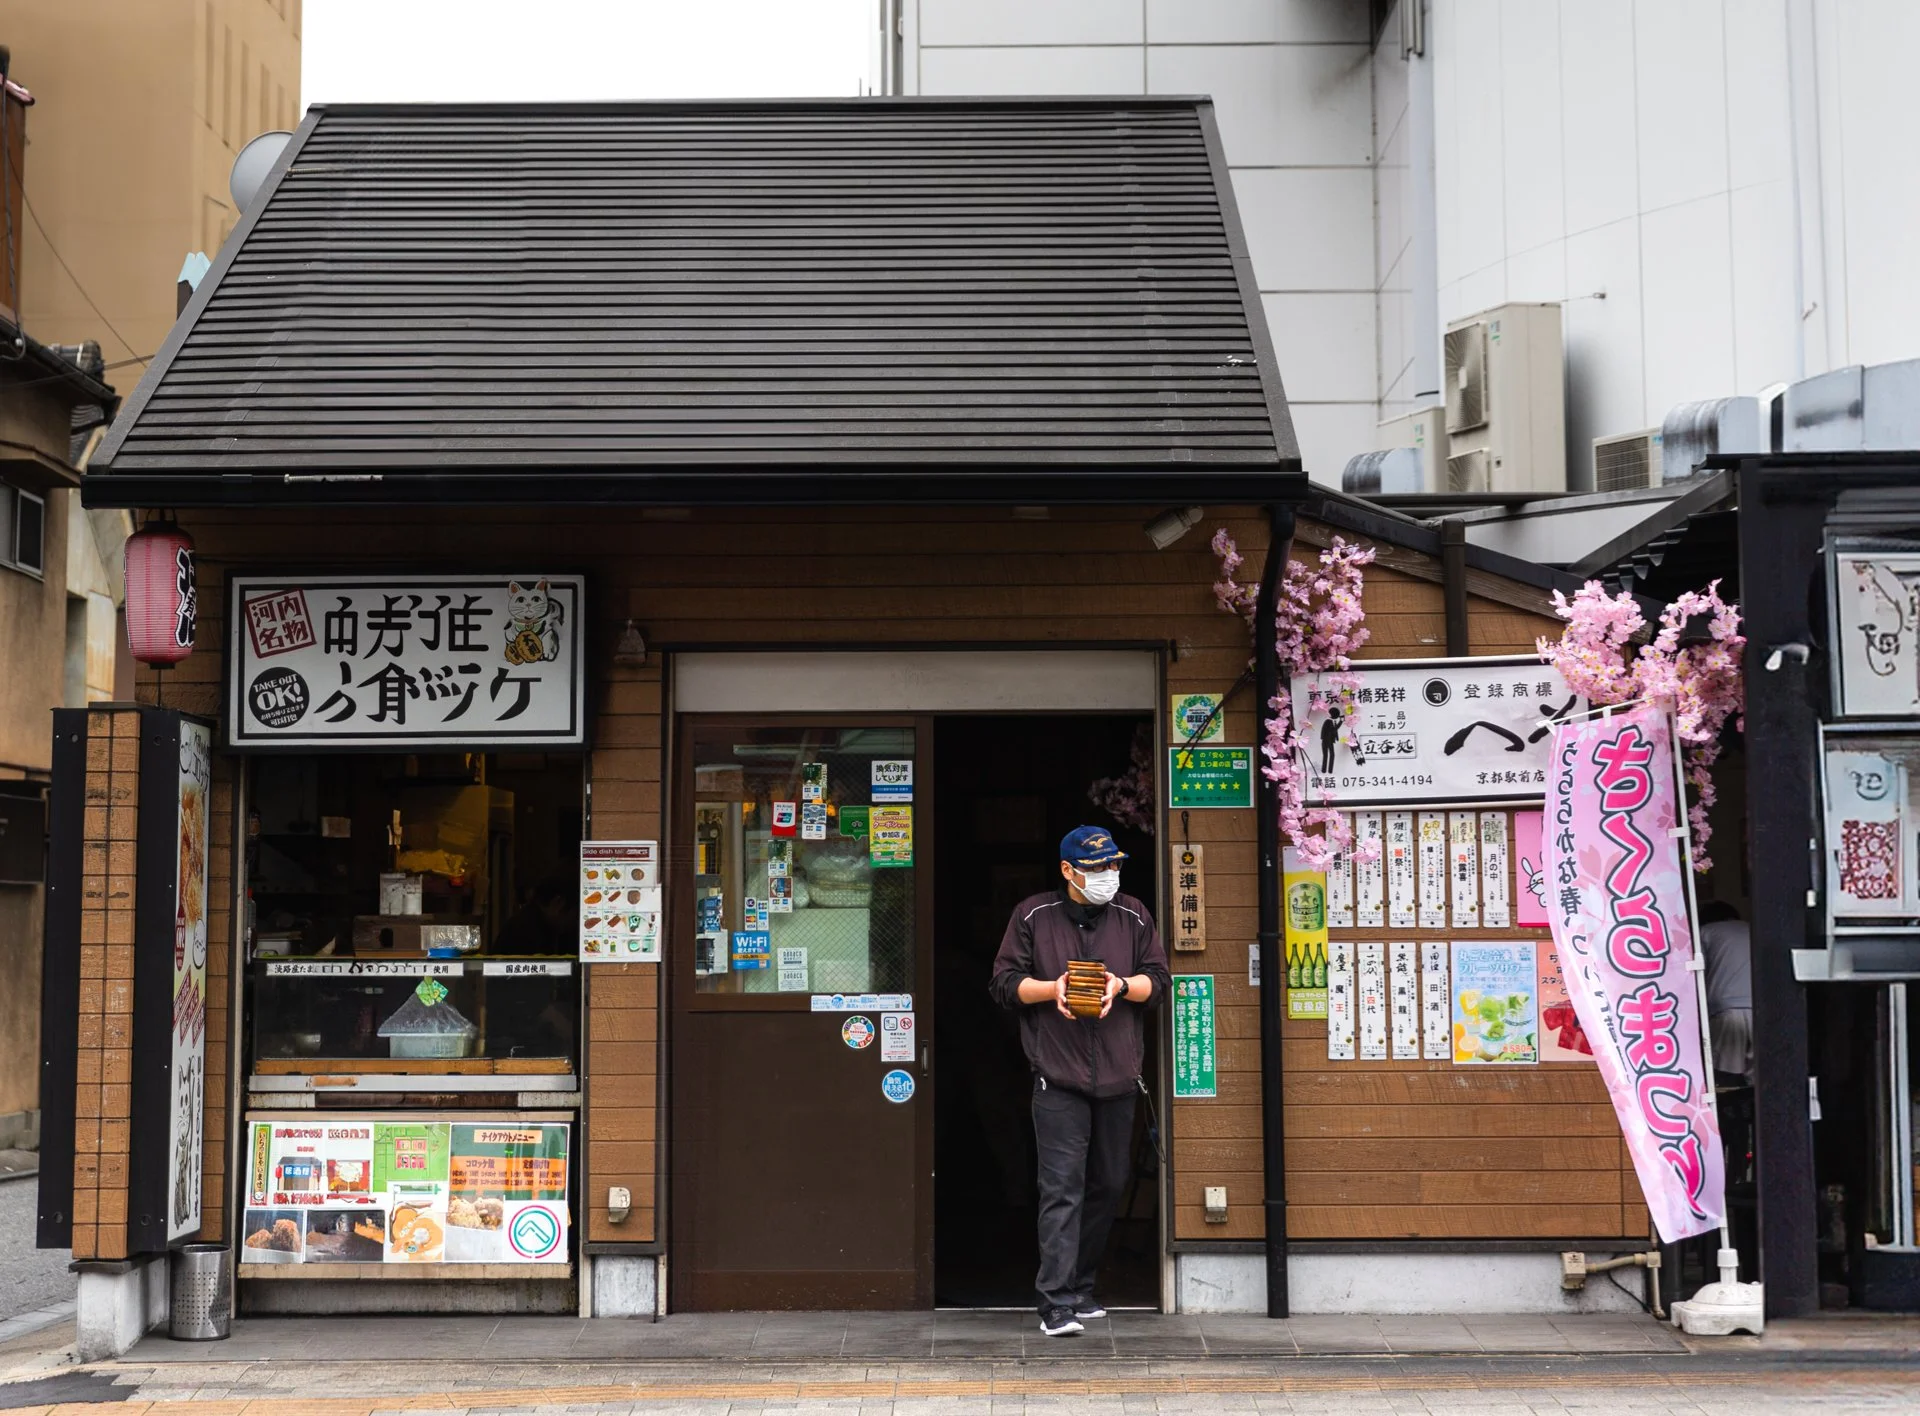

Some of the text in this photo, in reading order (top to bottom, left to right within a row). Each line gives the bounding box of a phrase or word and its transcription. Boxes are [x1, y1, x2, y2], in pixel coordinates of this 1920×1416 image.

[252, 596, 302, 627] 河内
[260, 620, 309, 649] 名物
[253, 673, 298, 692] TAKE OUT
[1464, 682, 1552, 699] 登録商標
[256, 682, 304, 711] OK!
[1308, 687, 1406, 704] 東京橋発祥
[876, 764, 908, 773] 換気対策
[1476, 769, 1546, 785] 京都駅前店
[1311, 774, 1433, 789] 電話 075-341-4194
[1458, 854, 1467, 881] 飛露喜
[1489, 853, 1498, 881] 月の中
[1179, 873, 1198, 934] 準備中
[736, 937, 767, 947] Wi-Fi
[1458, 948, 1513, 961] 丸ごと冷凍
[505, 964, 547, 974] 国産肉使用
[1459, 963, 1532, 975] フルーツサワー
[1335, 985, 1344, 1012] 魔王
[1367, 986, 1376, 1014] 十四代
[1430, 984, 1439, 1011] 田酒
[481, 1132, 535, 1142] テイクアウトメニュー
